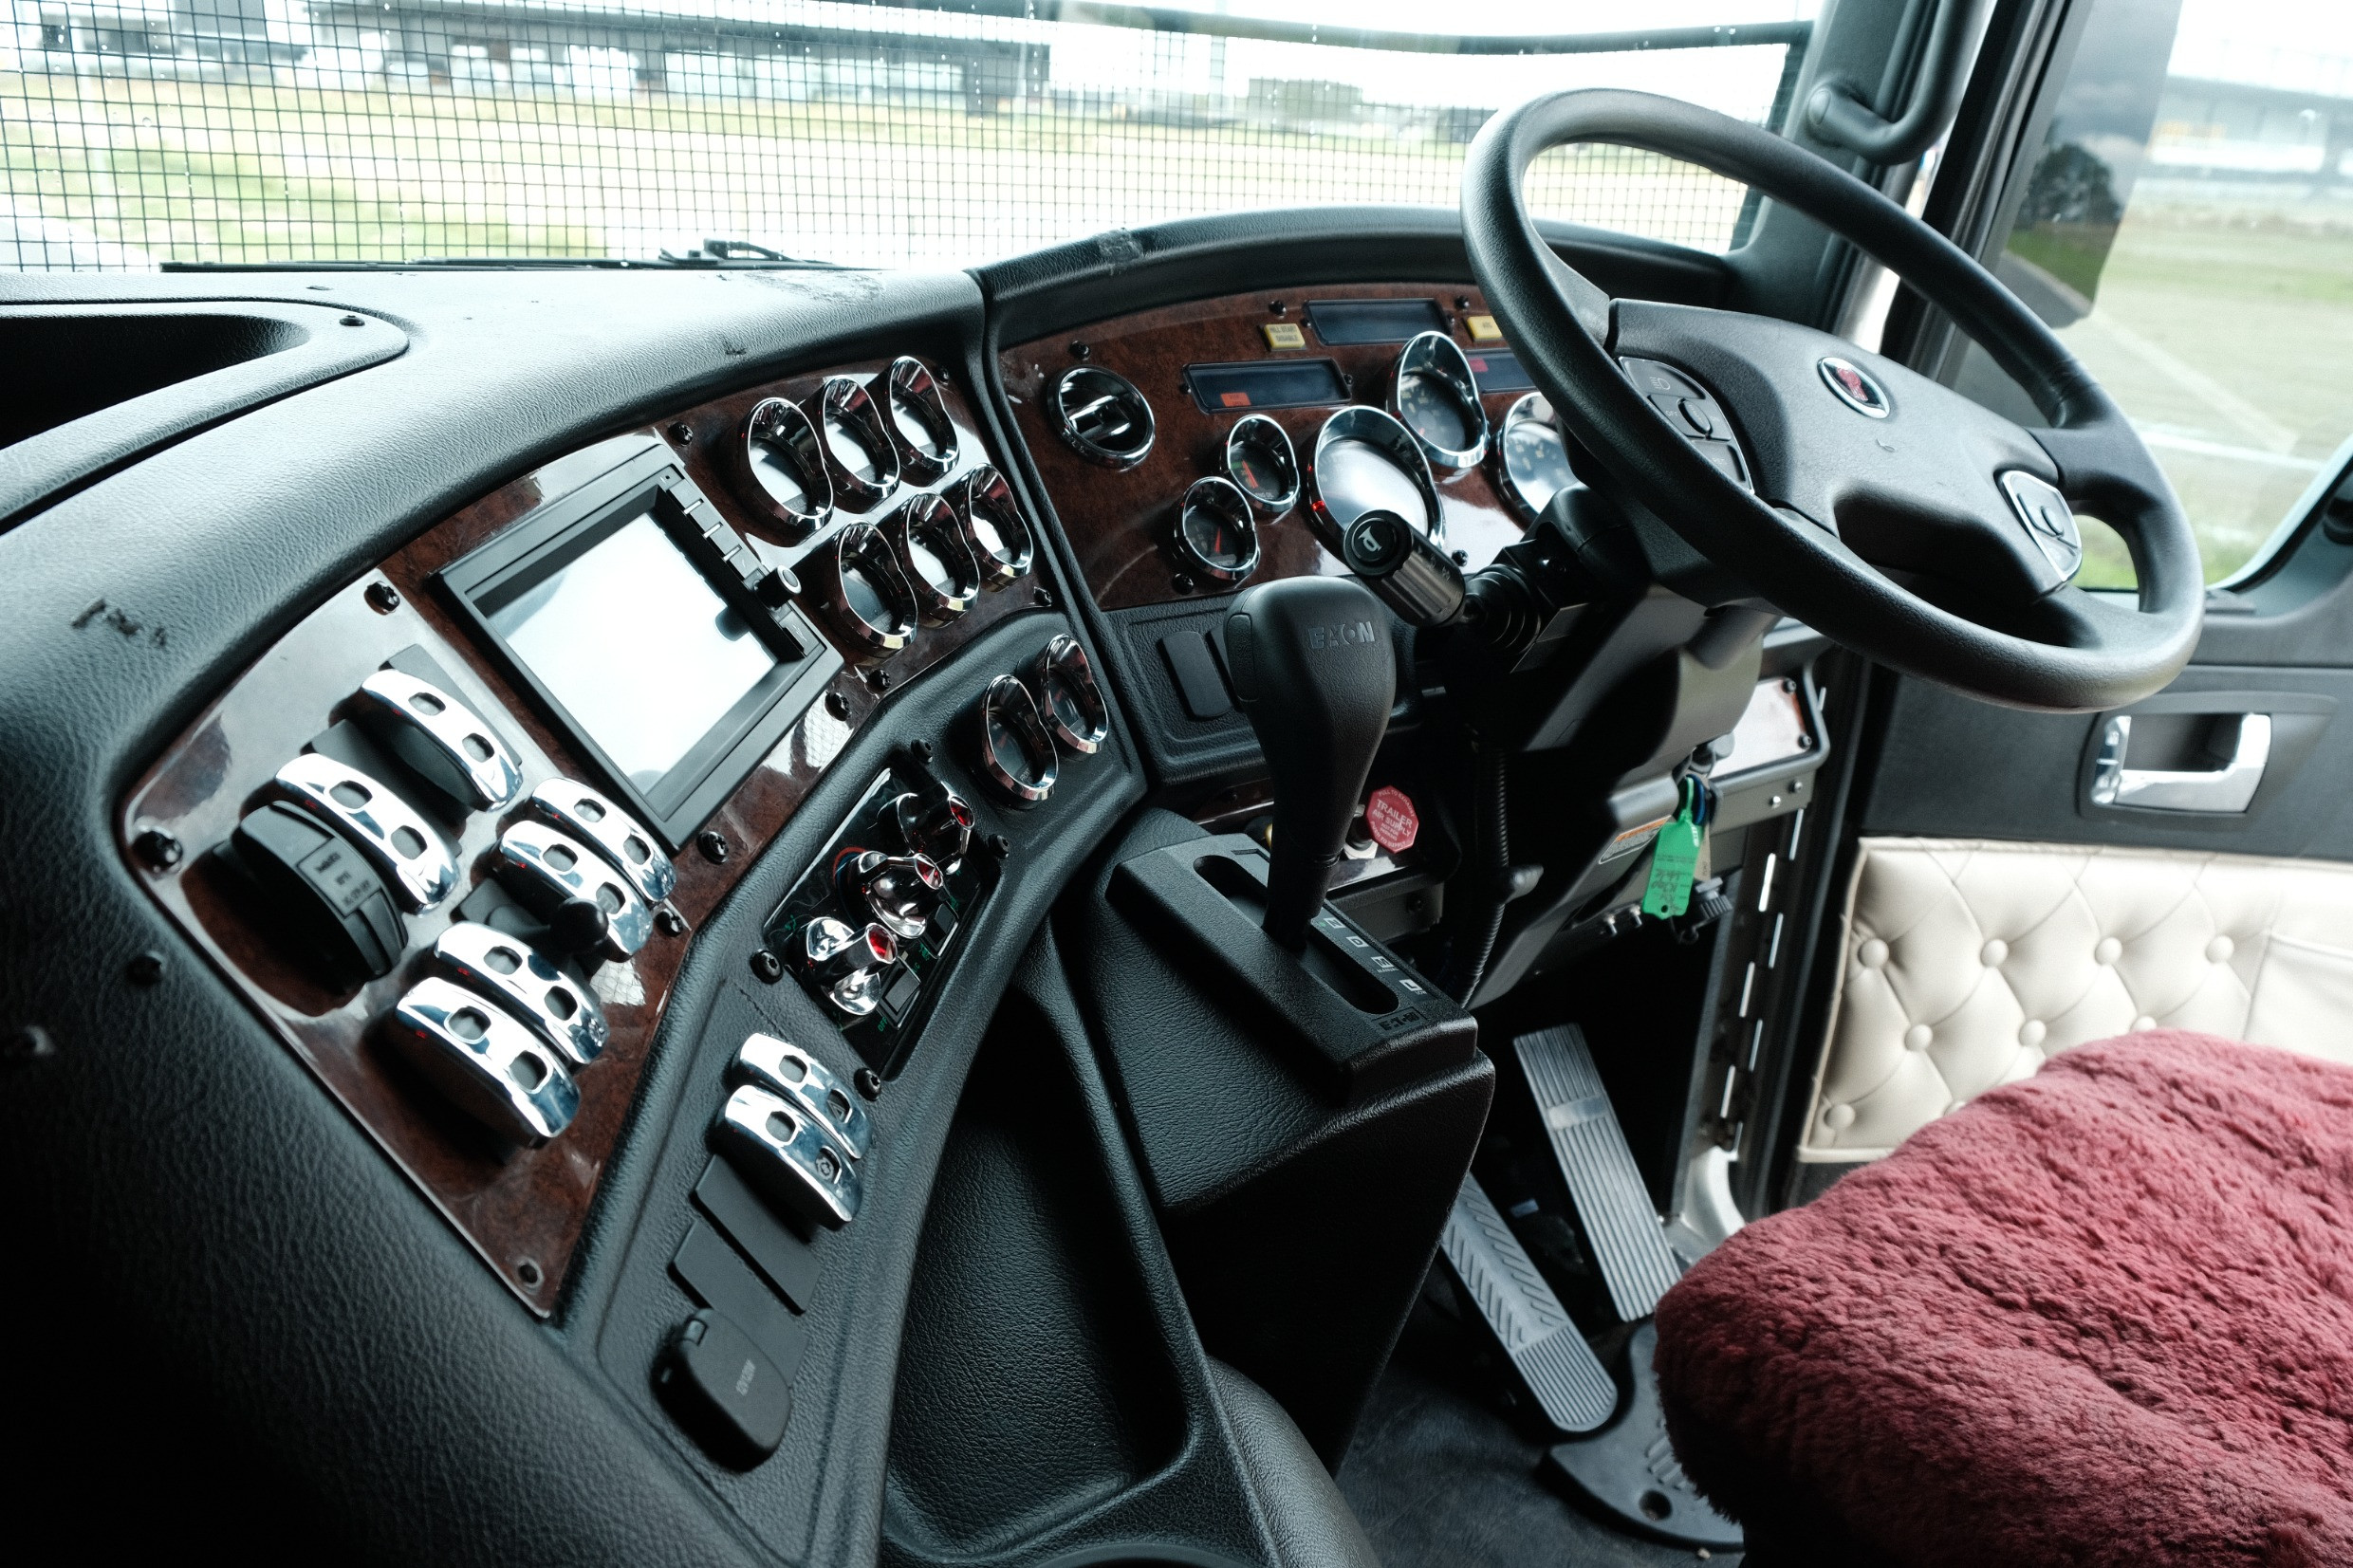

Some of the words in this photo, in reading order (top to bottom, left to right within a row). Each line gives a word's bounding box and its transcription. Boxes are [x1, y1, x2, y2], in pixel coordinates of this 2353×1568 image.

[1308, 620, 1375, 649] EATON
[1372, 809, 1385, 821] AIR
[1384, 817, 1412, 837] SUPPLY
[1377, 799, 1413, 828] TRAILER
[878, 1016, 888, 1032] OFF
